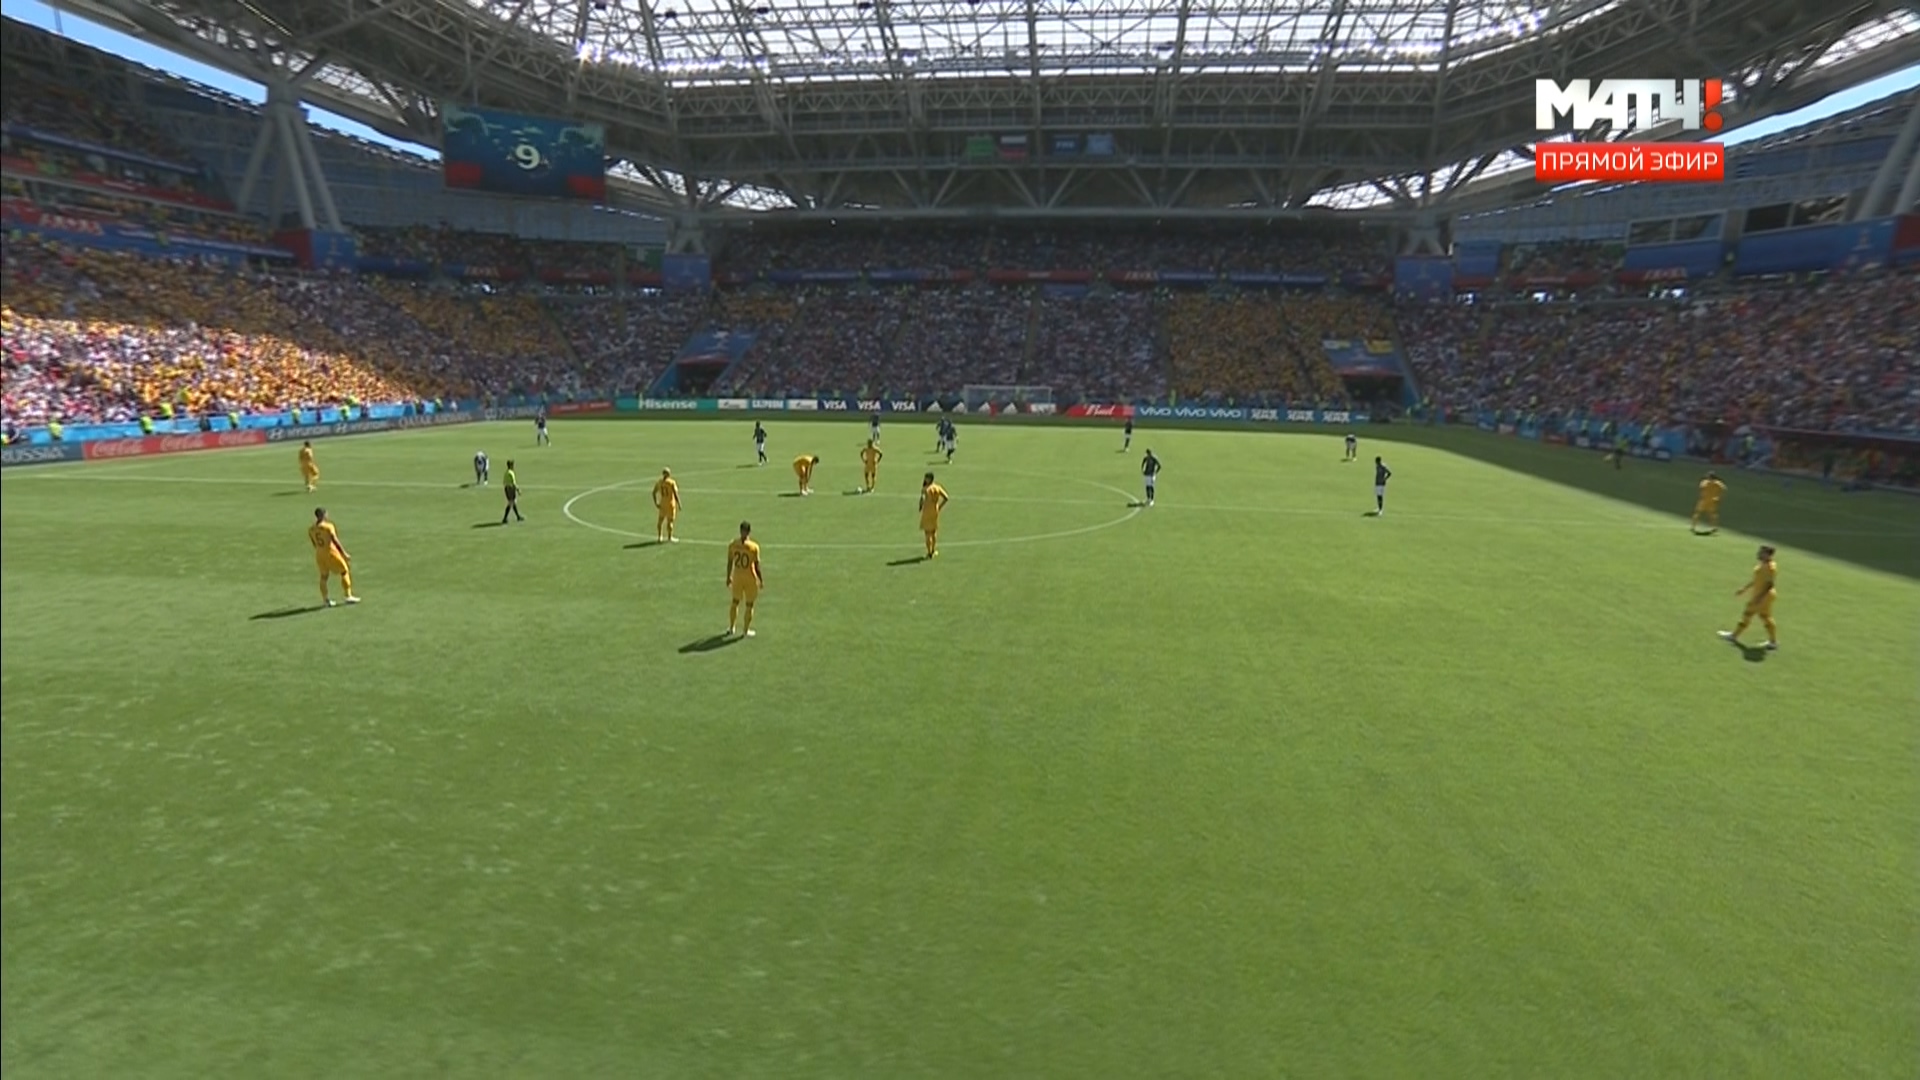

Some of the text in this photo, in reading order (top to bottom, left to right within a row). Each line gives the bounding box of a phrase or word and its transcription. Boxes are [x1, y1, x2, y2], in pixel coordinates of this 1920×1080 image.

[515, 144, 541, 170] 9
[639, 397, 697, 410] Hisense
[823, 400, 847, 411] VISA
[857, 400, 881, 411] VISA
[891, 400, 916, 411] VISA
[734, 551, 750, 569] 20
